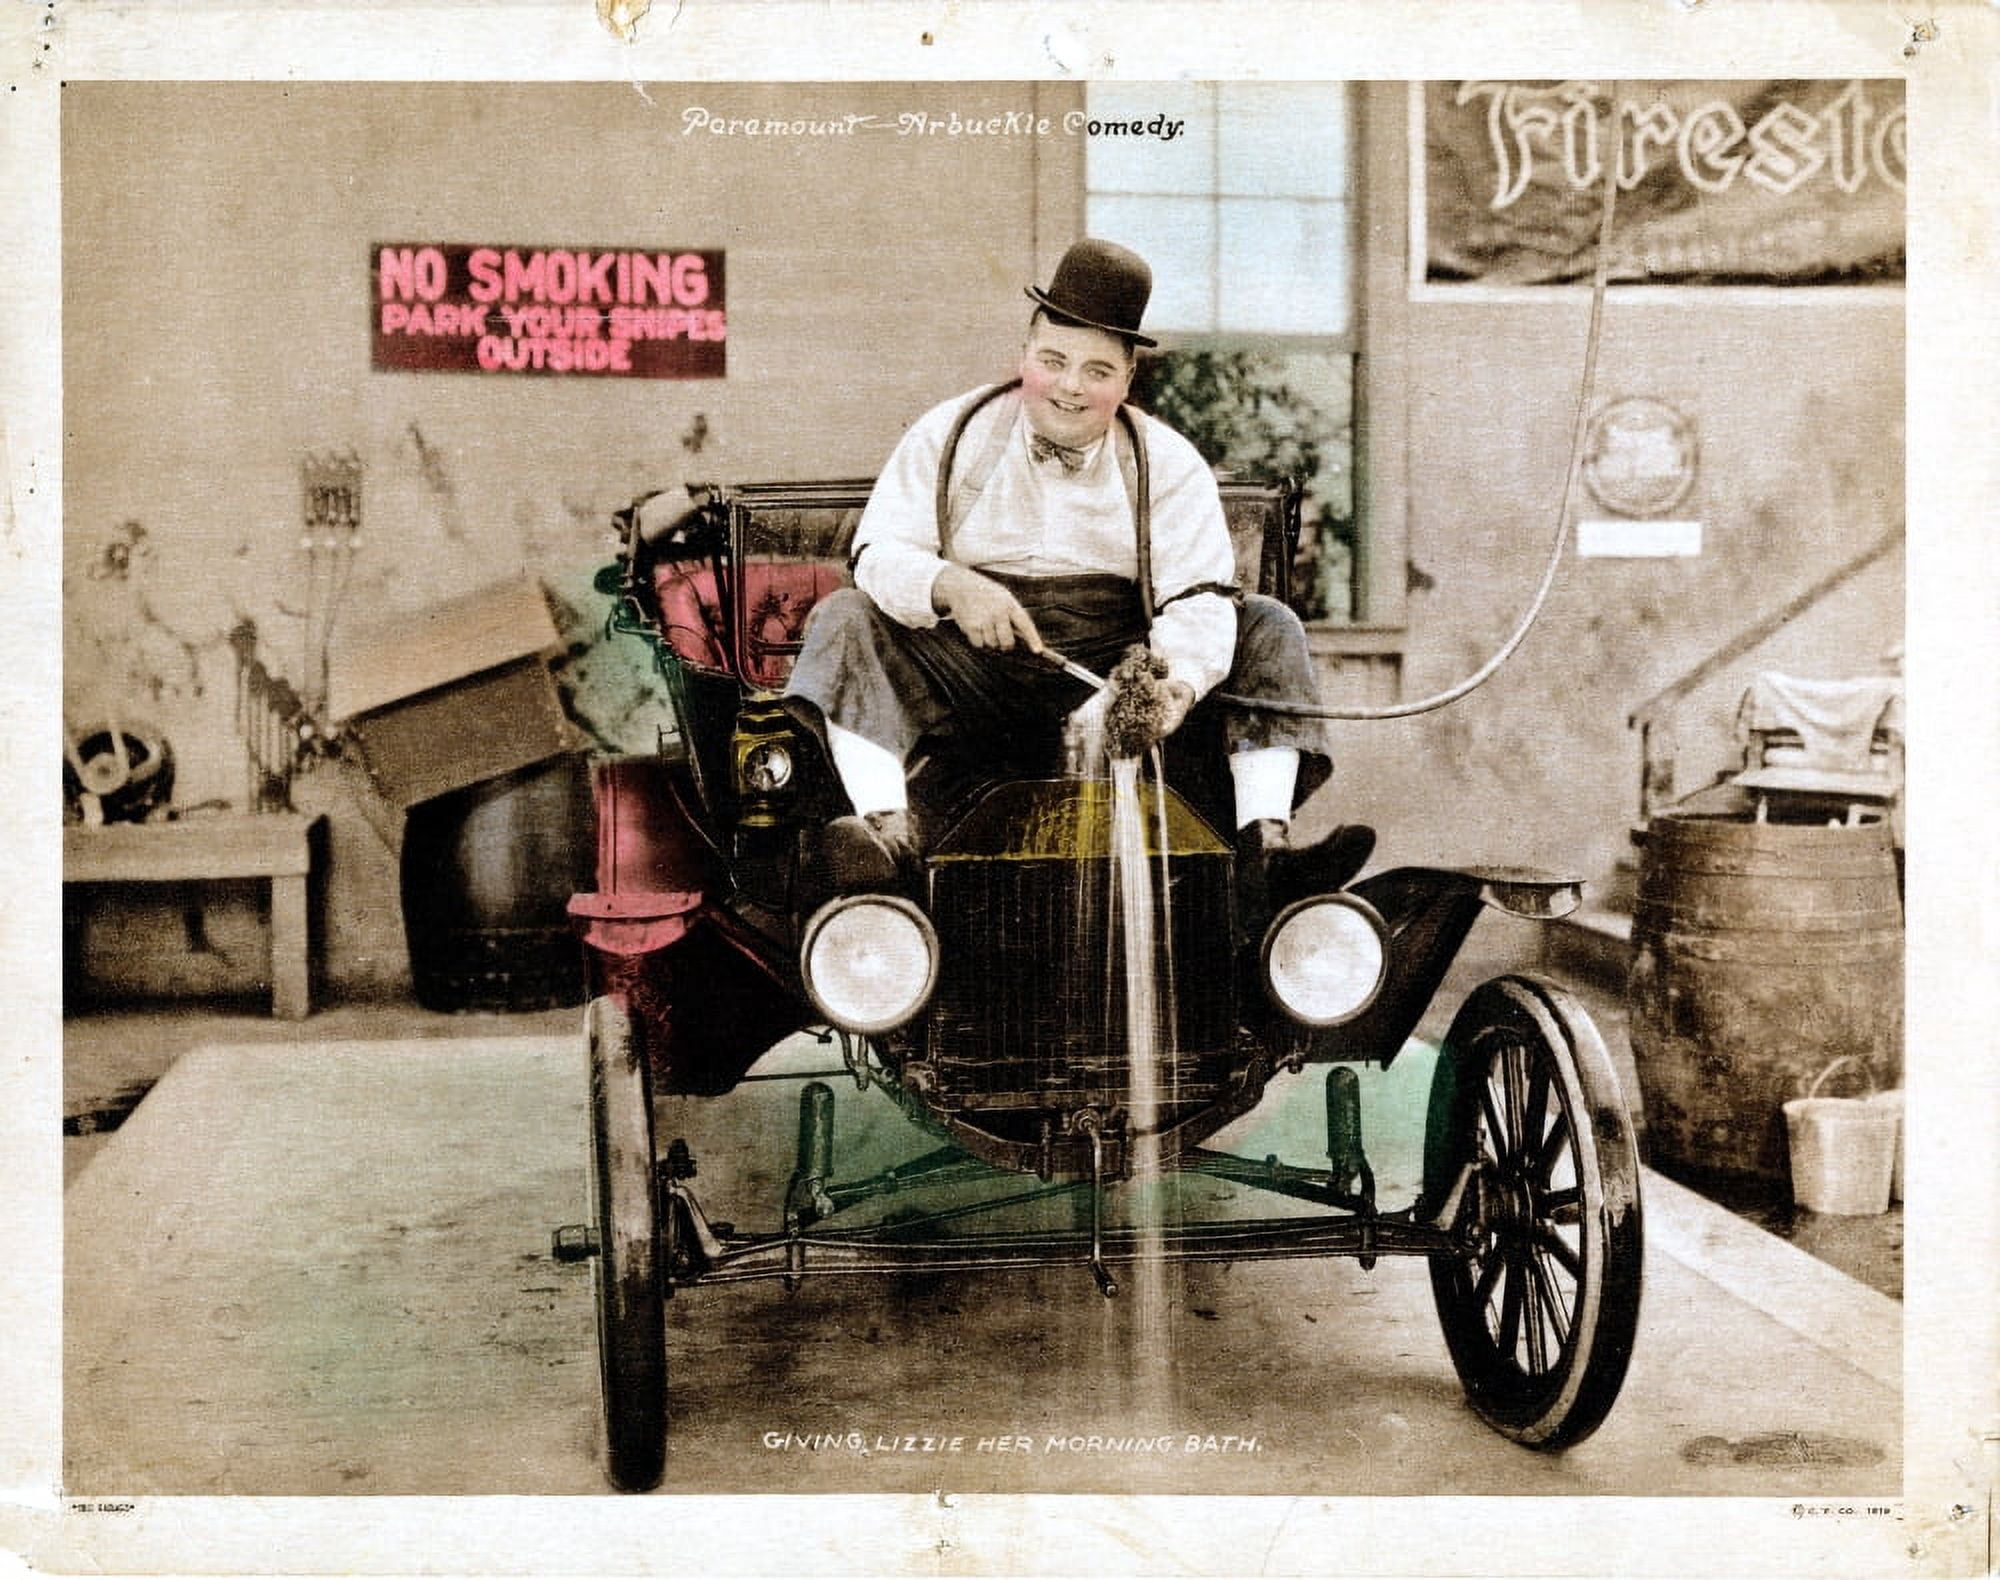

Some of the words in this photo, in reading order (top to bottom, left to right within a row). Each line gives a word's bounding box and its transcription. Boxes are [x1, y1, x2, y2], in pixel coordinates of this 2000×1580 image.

[379, 247, 448, 302] NO
[467, 248, 709, 307] SMOKING
[382, 303, 490, 337] PARK
[501, 304, 602, 339] YOUR
[477, 335, 632, 371] OUTSIDE
